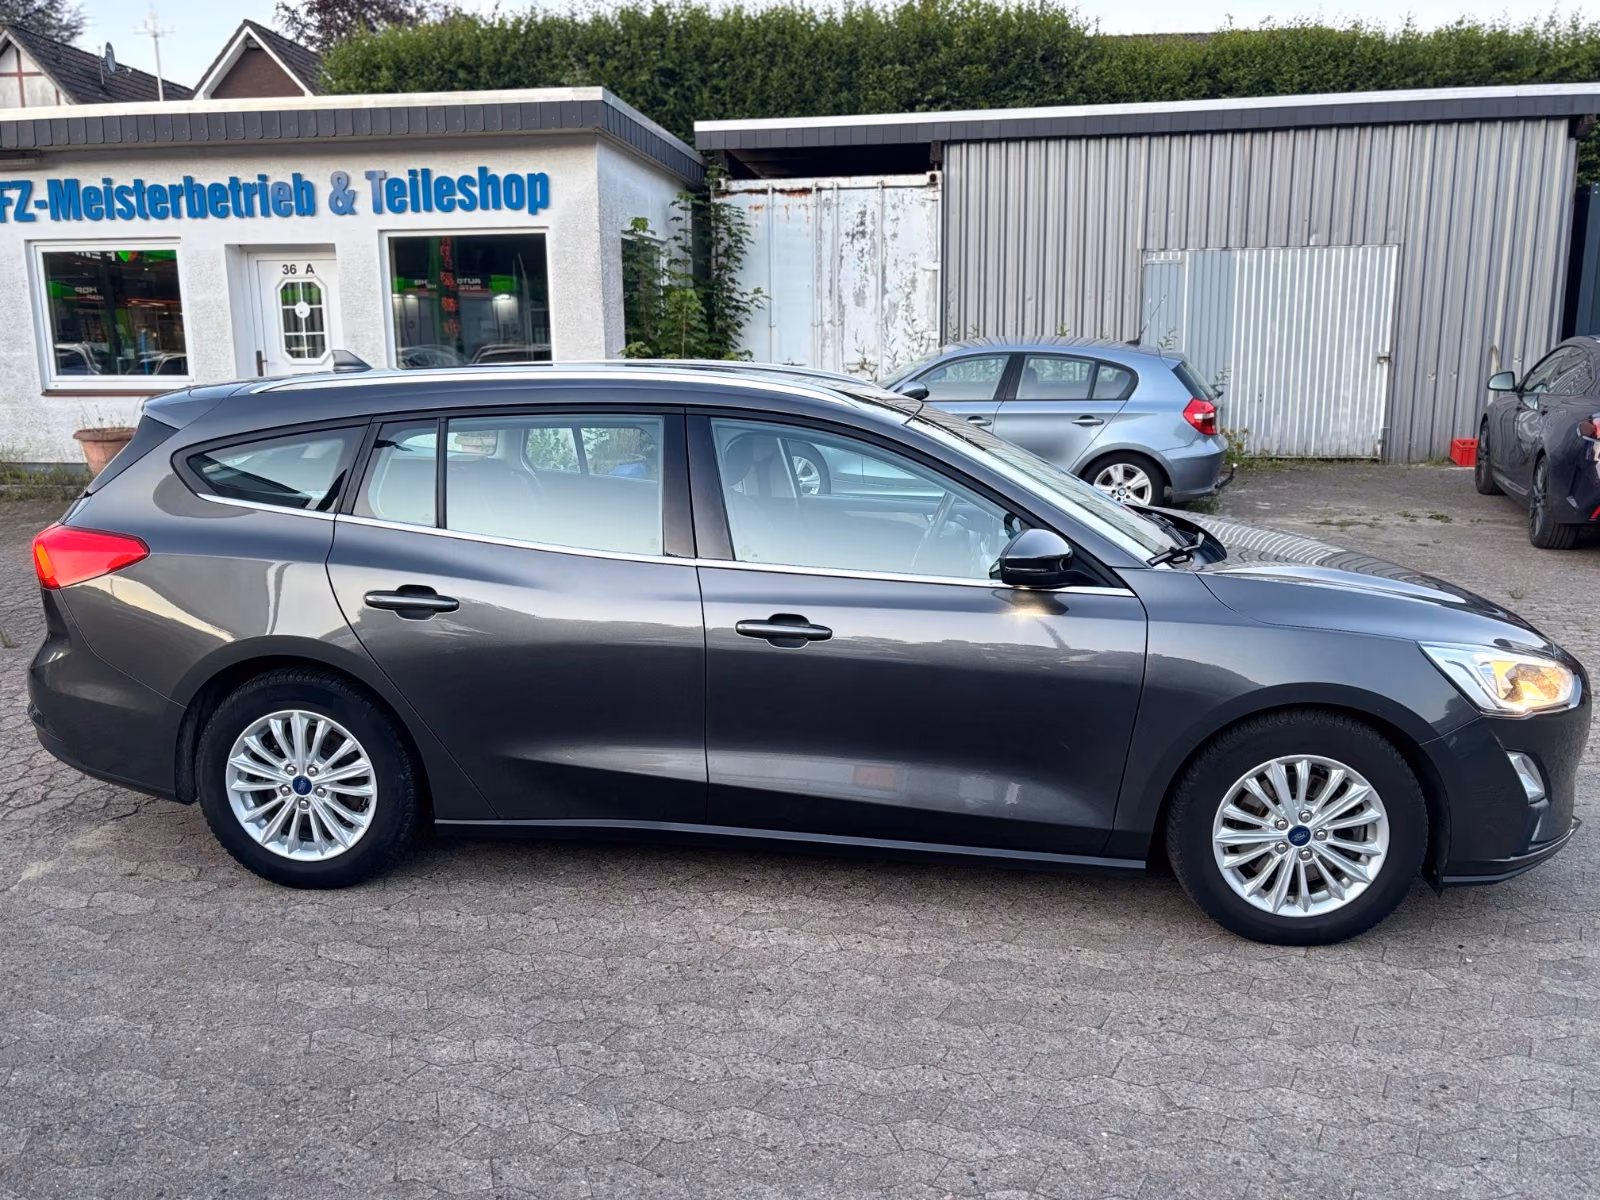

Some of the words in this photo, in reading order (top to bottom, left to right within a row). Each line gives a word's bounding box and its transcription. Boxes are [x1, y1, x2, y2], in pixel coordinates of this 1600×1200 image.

[328, 171, 356, 216] &
[365, 166, 550, 216] Teileshop
[282, 264, 297, 275] 36
[305, 263, 315, 275] A
